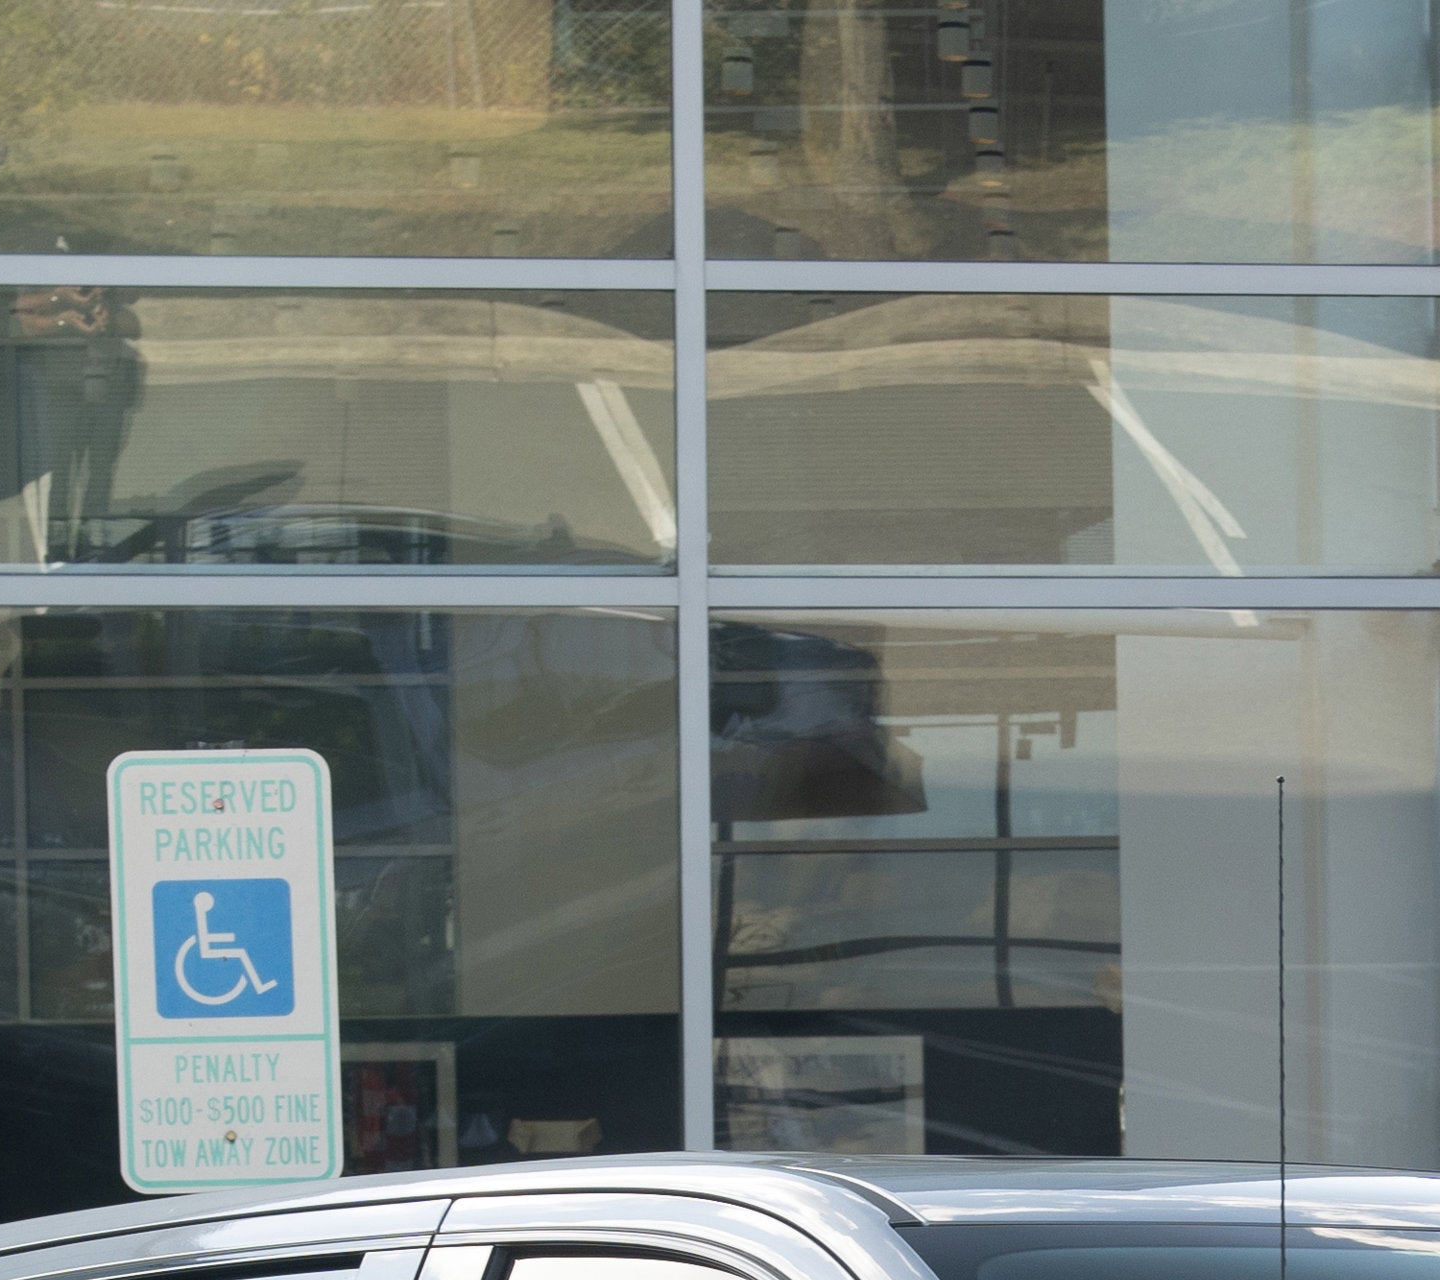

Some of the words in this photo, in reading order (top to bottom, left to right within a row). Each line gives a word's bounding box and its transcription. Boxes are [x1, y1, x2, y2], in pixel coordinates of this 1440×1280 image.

[138, 778, 298, 816] RESERVED
[154, 826, 287, 862] PARKING
[174, 1052, 281, 1084] PENALTY
[139, 1095, 265, 1126] $100-$500
[275, 1093, 321, 1123] FINE
[142, 1138, 187, 1168] TOW
[195, 1137, 254, 1167] AWAY
[265, 1135, 321, 1166] ZONE
